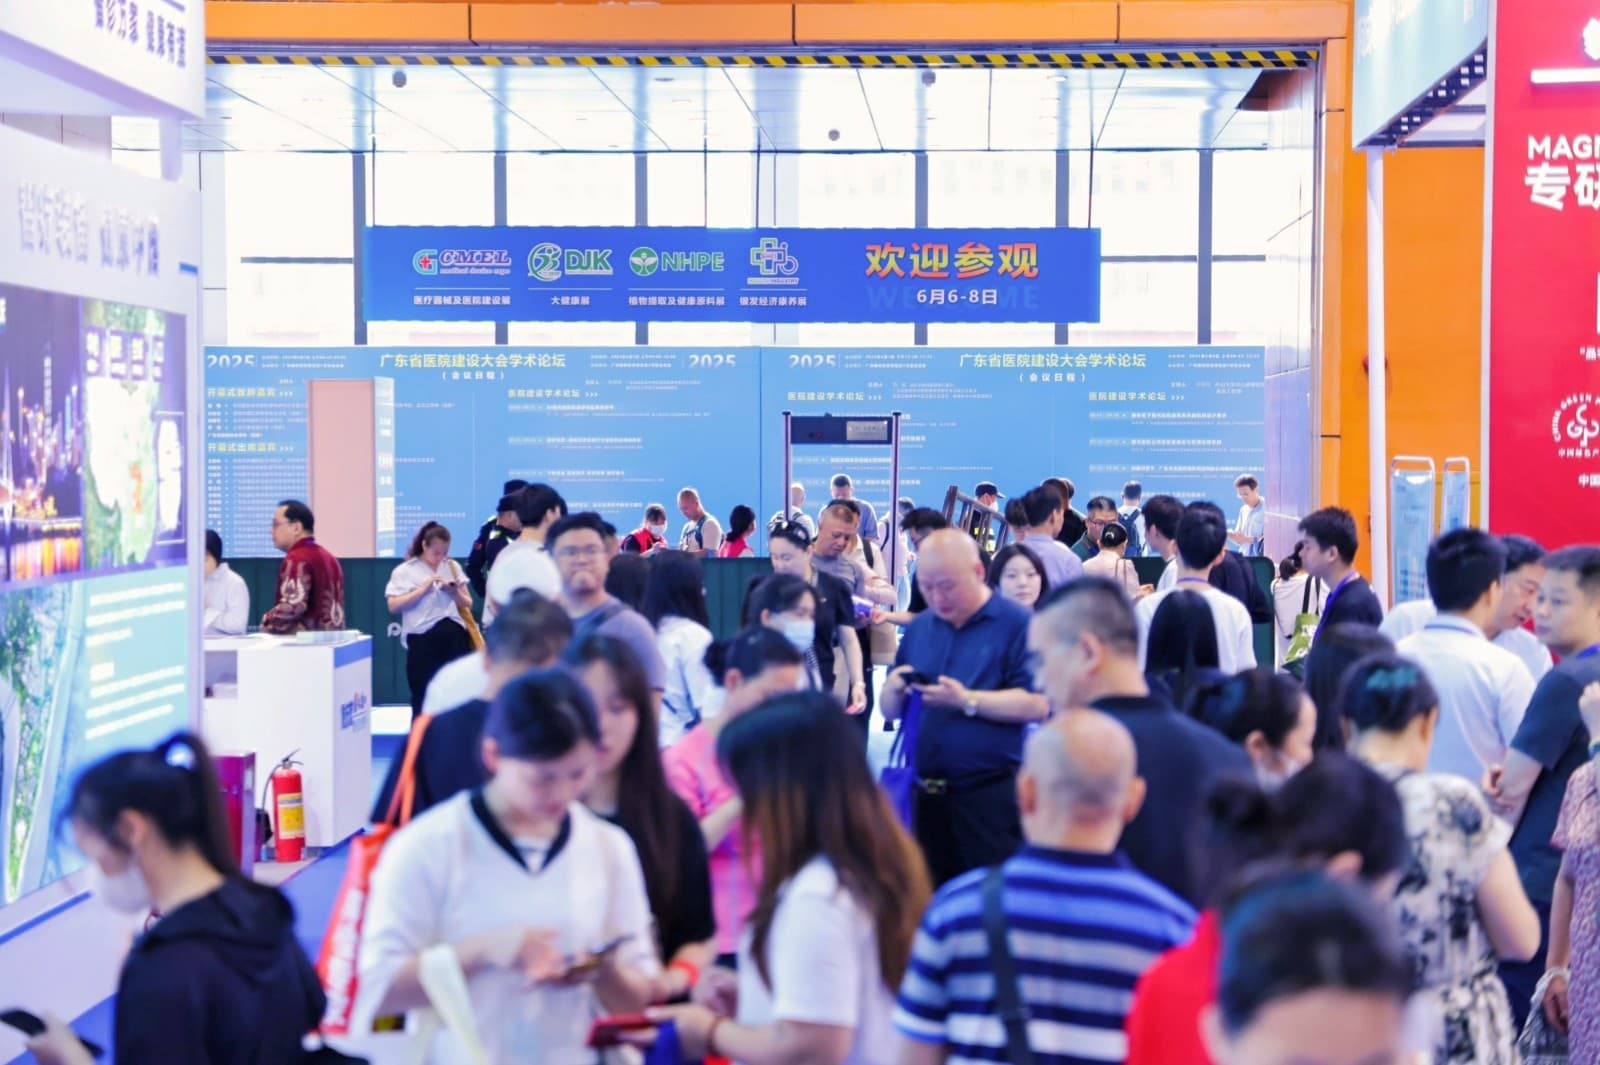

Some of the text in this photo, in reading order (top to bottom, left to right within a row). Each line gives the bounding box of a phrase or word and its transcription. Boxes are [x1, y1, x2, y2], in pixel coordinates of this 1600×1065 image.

[564, 249, 613, 274] DJK
[661, 251, 725, 272] NHPE
[864, 241, 1040, 279] 欢迎参观
[916, 288, 998, 305] 6月6-8日
[207, 354, 256, 368] 2025
[380, 353, 566, 369] 广东省医院建设大会学术论坛
[688, 354, 736, 368] 2025
[789, 354, 837, 369] 2025
[959, 353, 1147, 369] 广东省医院建设大会学术论坛
